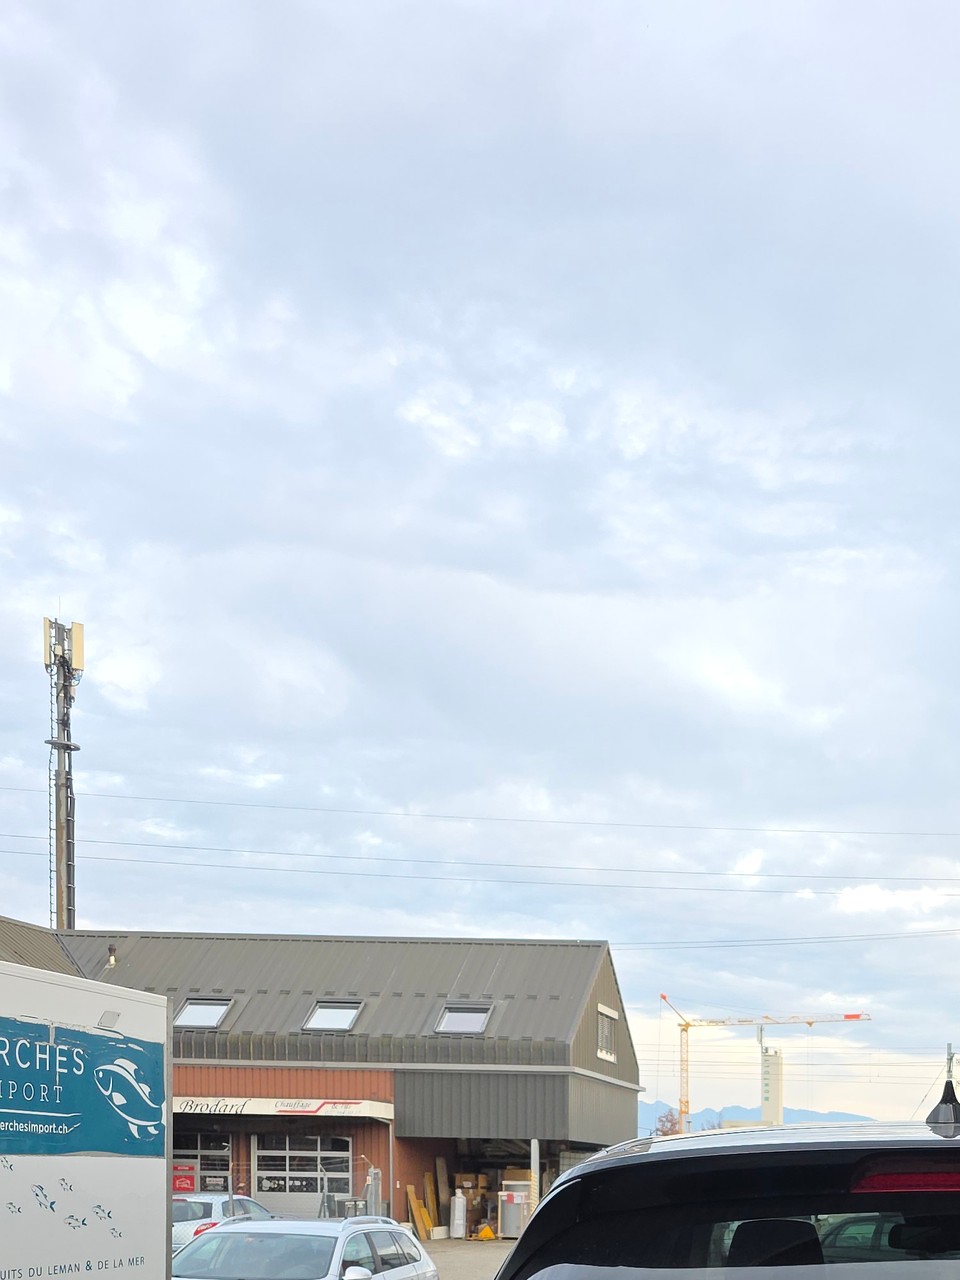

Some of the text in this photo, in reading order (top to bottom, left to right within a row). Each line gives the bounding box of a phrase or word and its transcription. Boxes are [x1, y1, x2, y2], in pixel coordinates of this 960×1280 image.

[0, 1079, 63, 1103] PORT
[179, 1098, 251, 1114] Brodard
[28, 1267, 43, 1278] DU
[48, 1263, 80, 1276] LEMAN
[85, 1260, 93, 1271] &
[97, 1260, 109, 1270] DE
[113, 1258, 124, 1268] LA
[127, 1256, 145, 1266] MER
